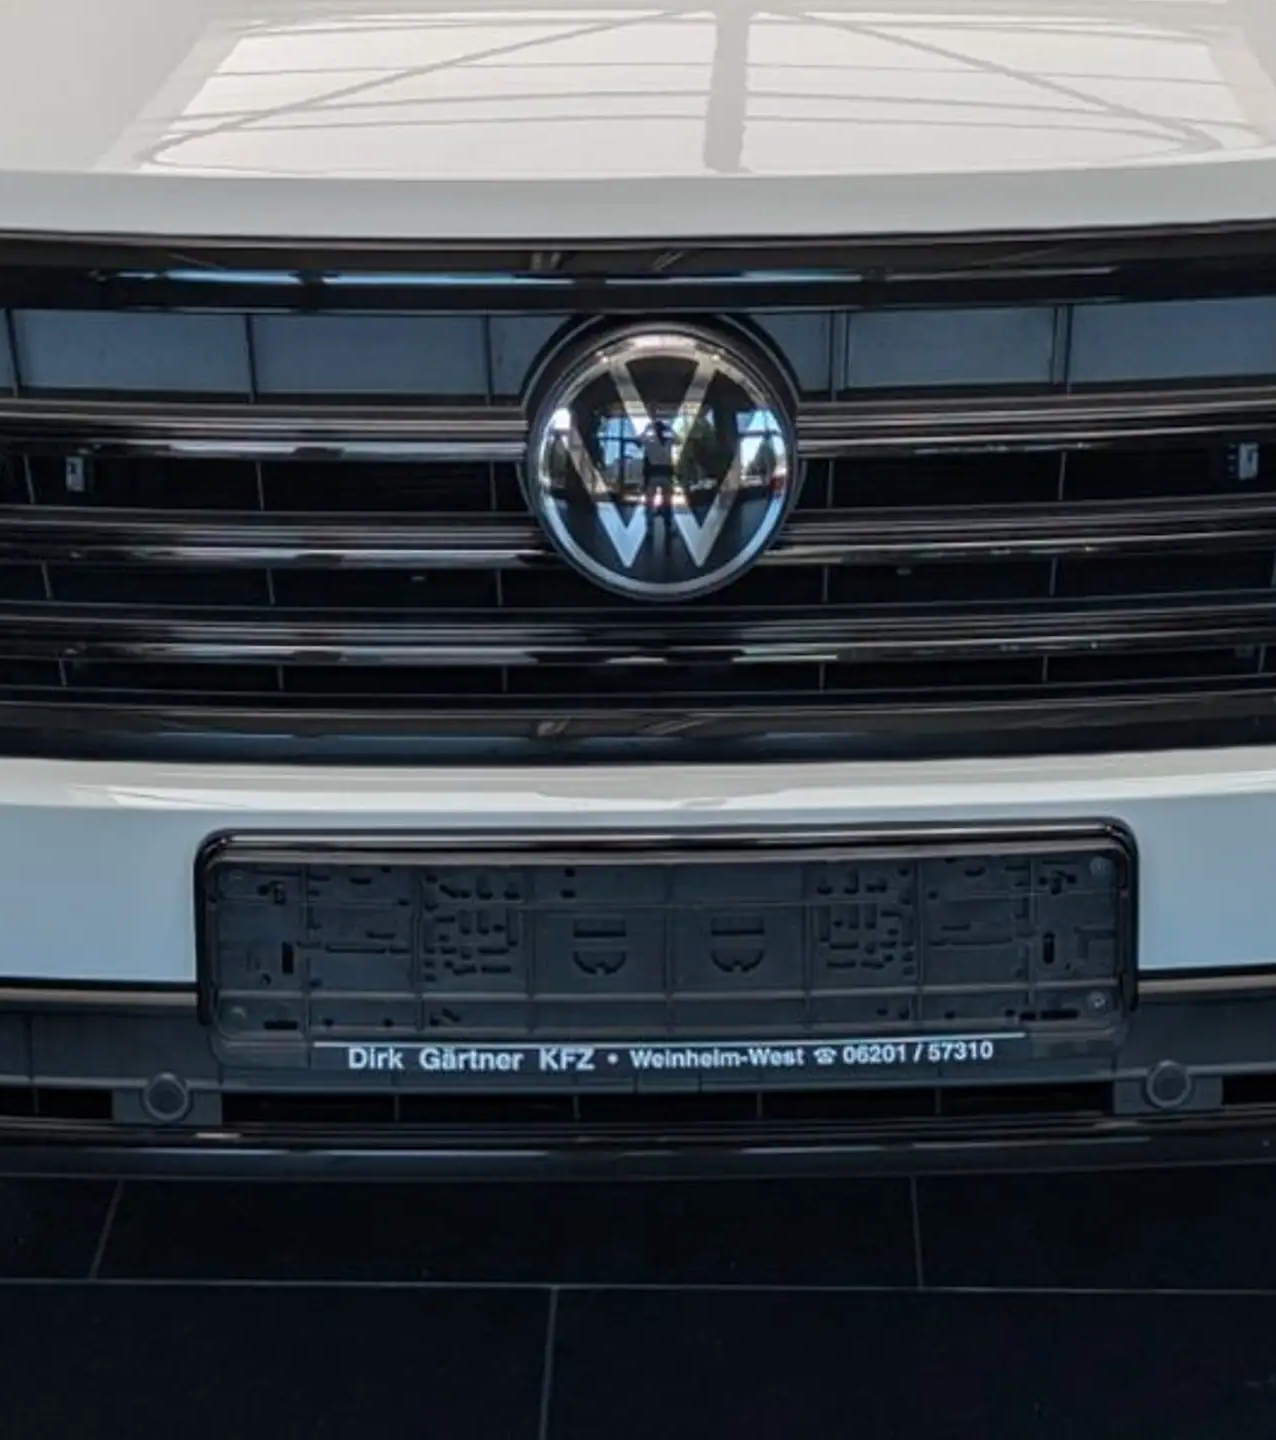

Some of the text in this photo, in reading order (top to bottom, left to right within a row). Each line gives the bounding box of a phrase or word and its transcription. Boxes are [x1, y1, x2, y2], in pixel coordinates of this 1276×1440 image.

[348, 1047, 405, 1070] Dirk
[418, 1046, 525, 1072] Gärtner
[538, 1047, 597, 1071] KFZ
[628, 1047, 805, 1069] Weinheim-West
